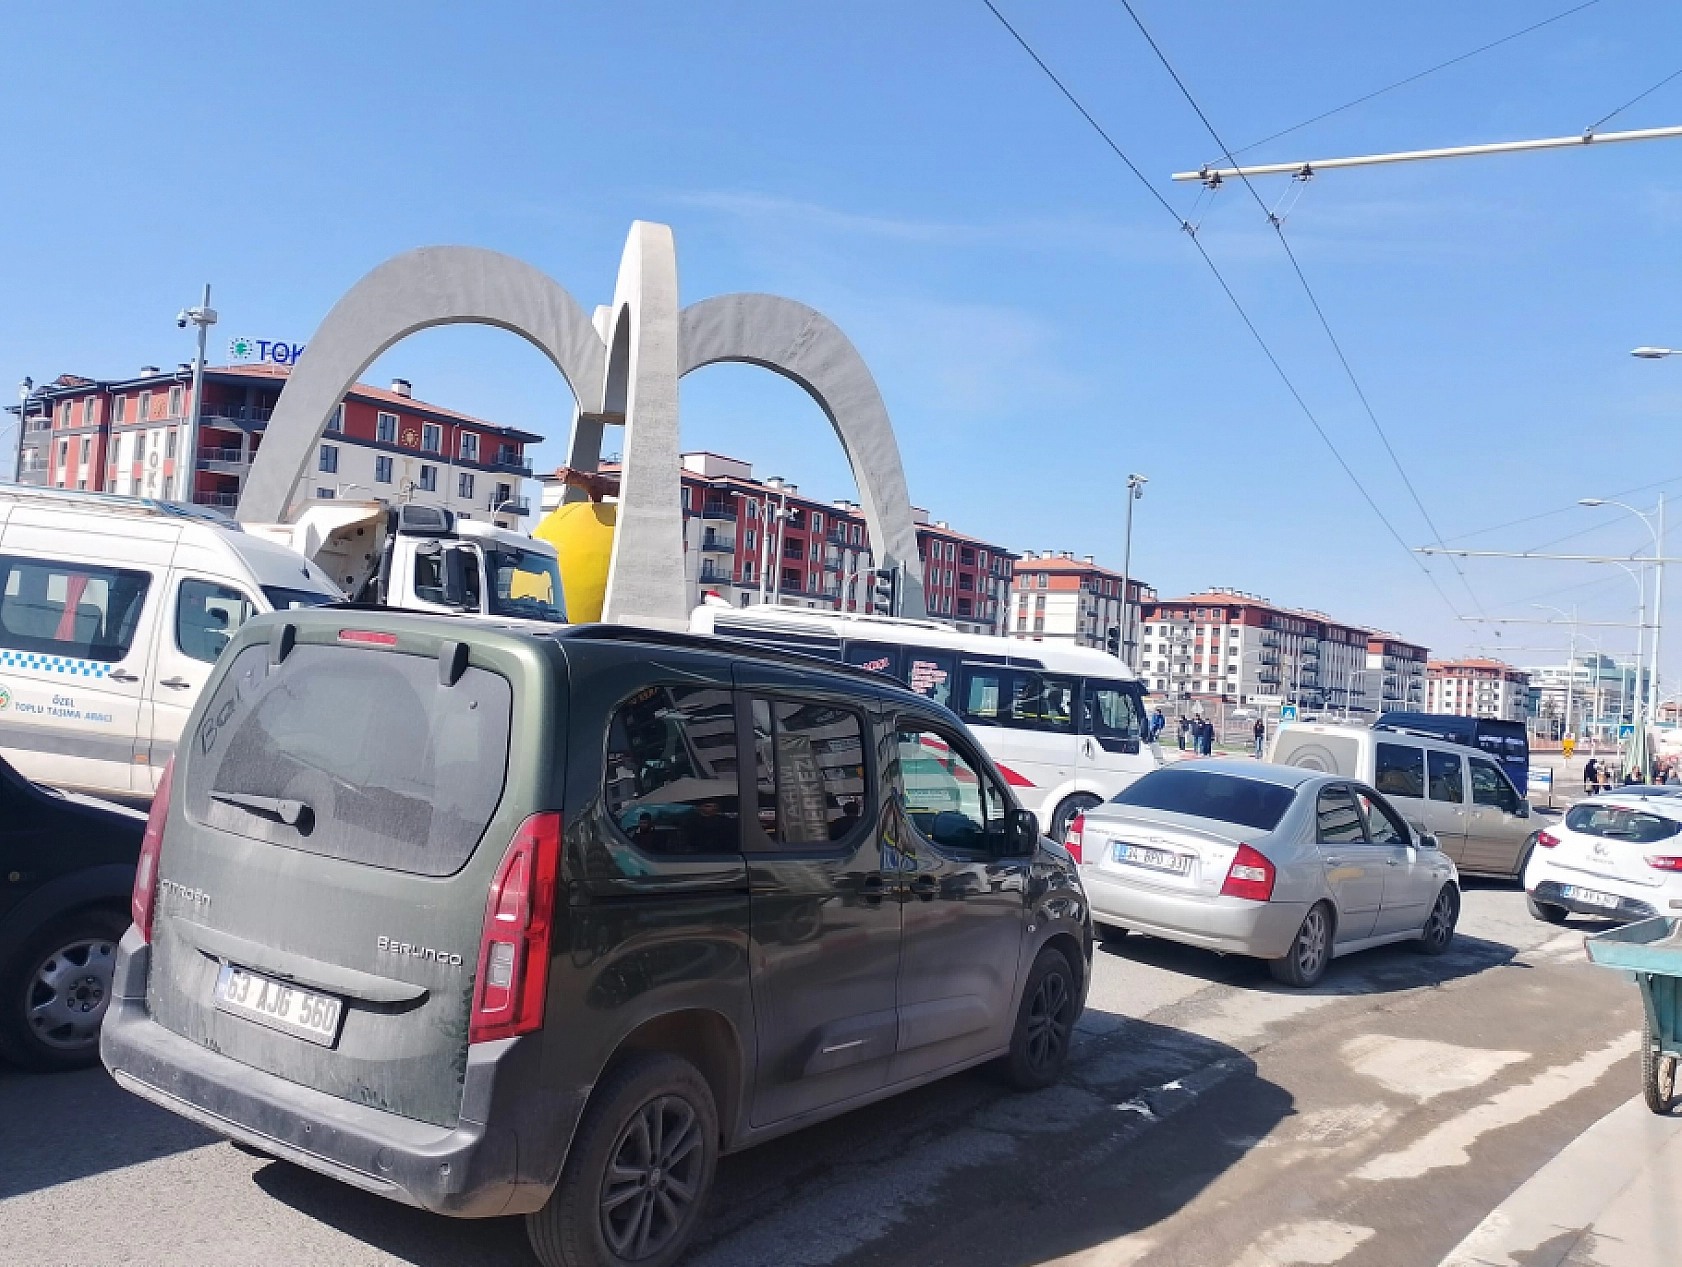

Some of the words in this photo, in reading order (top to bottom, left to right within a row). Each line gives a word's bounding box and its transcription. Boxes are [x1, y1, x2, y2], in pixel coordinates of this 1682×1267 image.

[15, 702, 44, 714] TOPLU
[52, 694, 75, 708] ÖZEL
[227, 972, 250, 1002] 63
[299, 993, 338, 1031] 560
